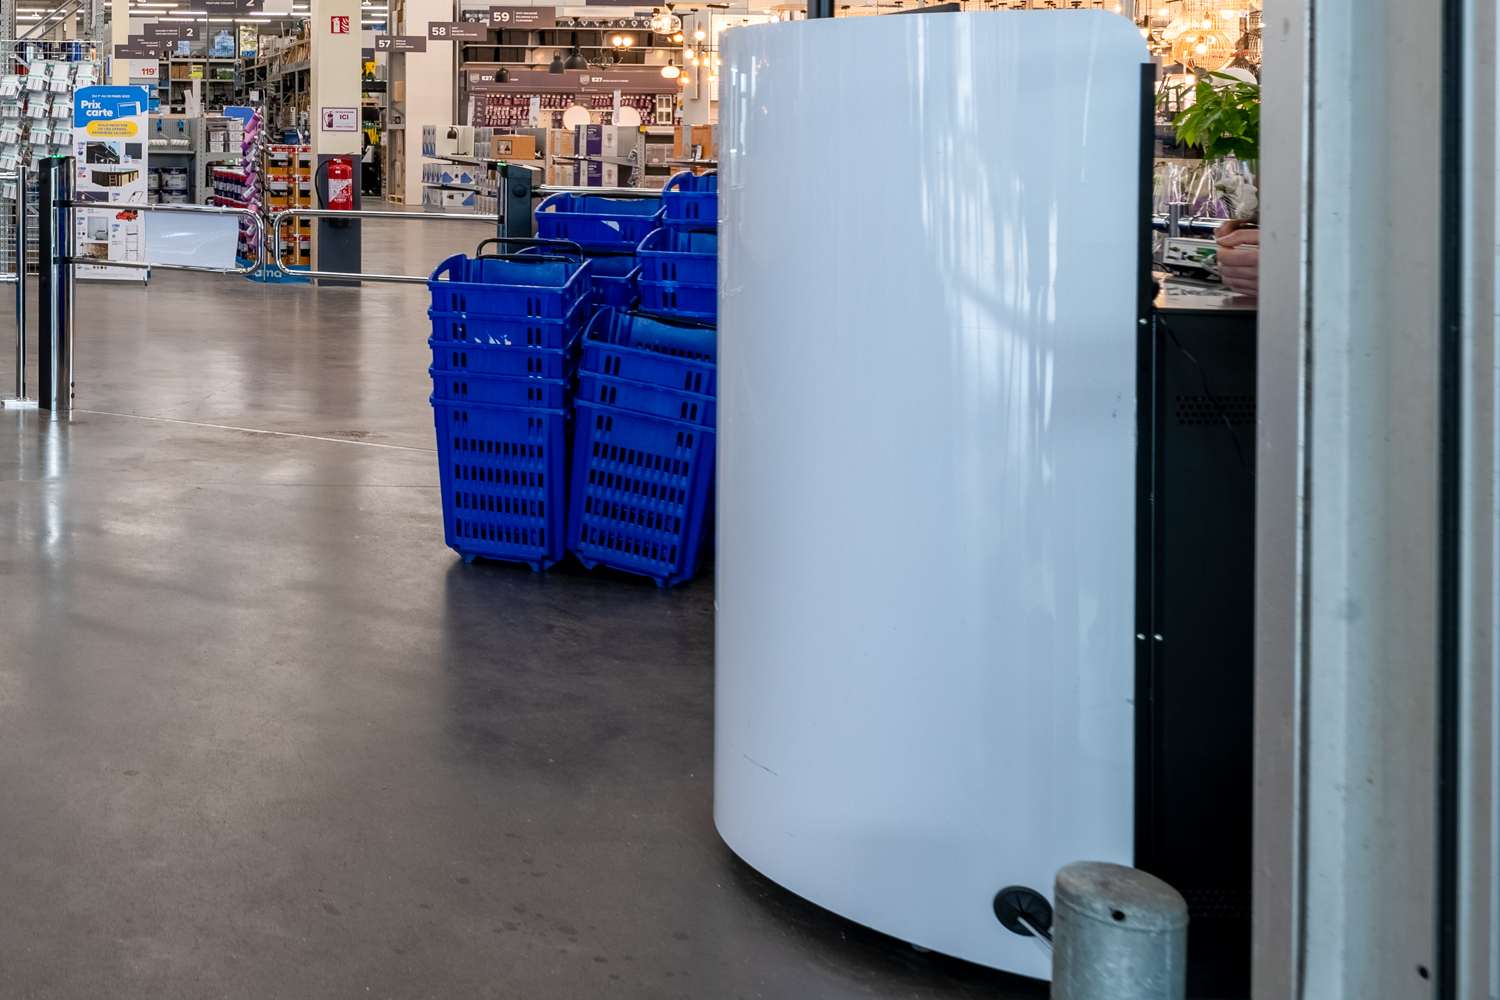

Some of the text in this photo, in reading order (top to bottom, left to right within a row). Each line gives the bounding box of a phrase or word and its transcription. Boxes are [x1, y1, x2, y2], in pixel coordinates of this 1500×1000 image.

[493, 12, 510, 22] 59
[186, 28, 193, 36] 2
[432, 27, 446, 36] 58
[379, 40, 391, 48] 57
[81, 99, 101, 109] Prix
[86, 109, 113, 117] carte
